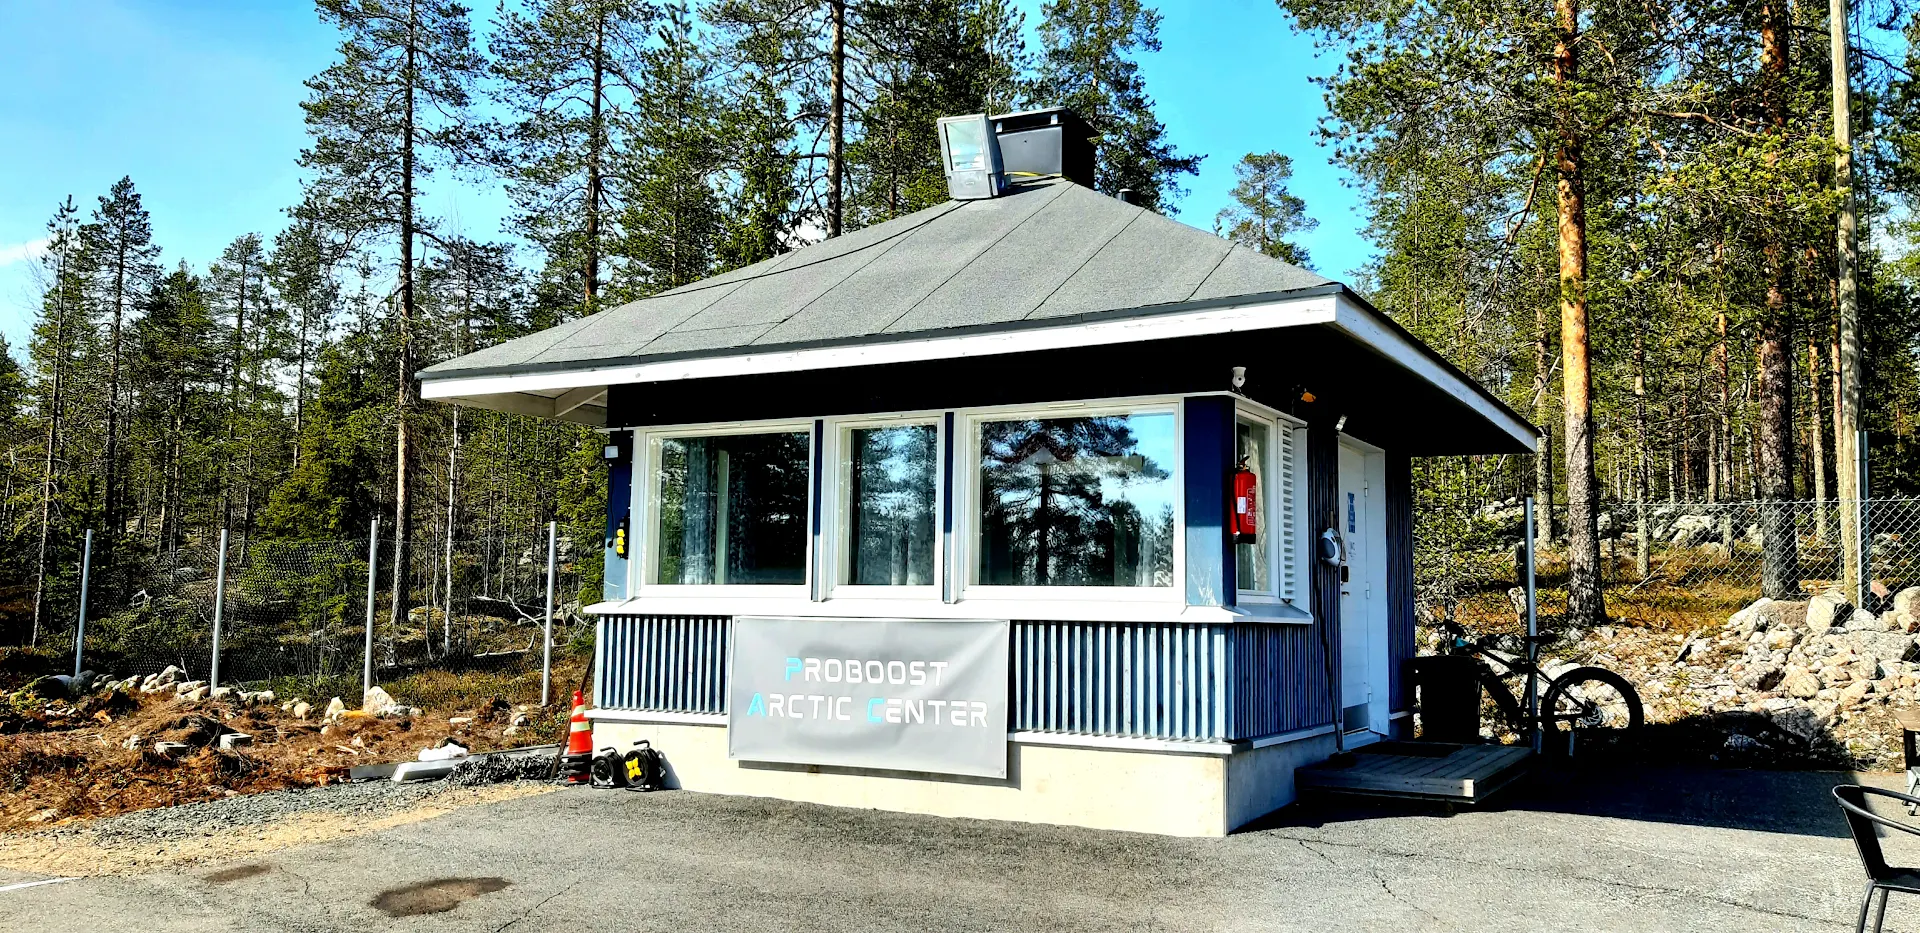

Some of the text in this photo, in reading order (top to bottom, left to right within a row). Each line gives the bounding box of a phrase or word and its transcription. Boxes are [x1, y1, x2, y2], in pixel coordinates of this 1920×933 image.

[785, 657, 948, 686] PROBOOST
[747, 692, 988, 728] ARCTIC CENTER
